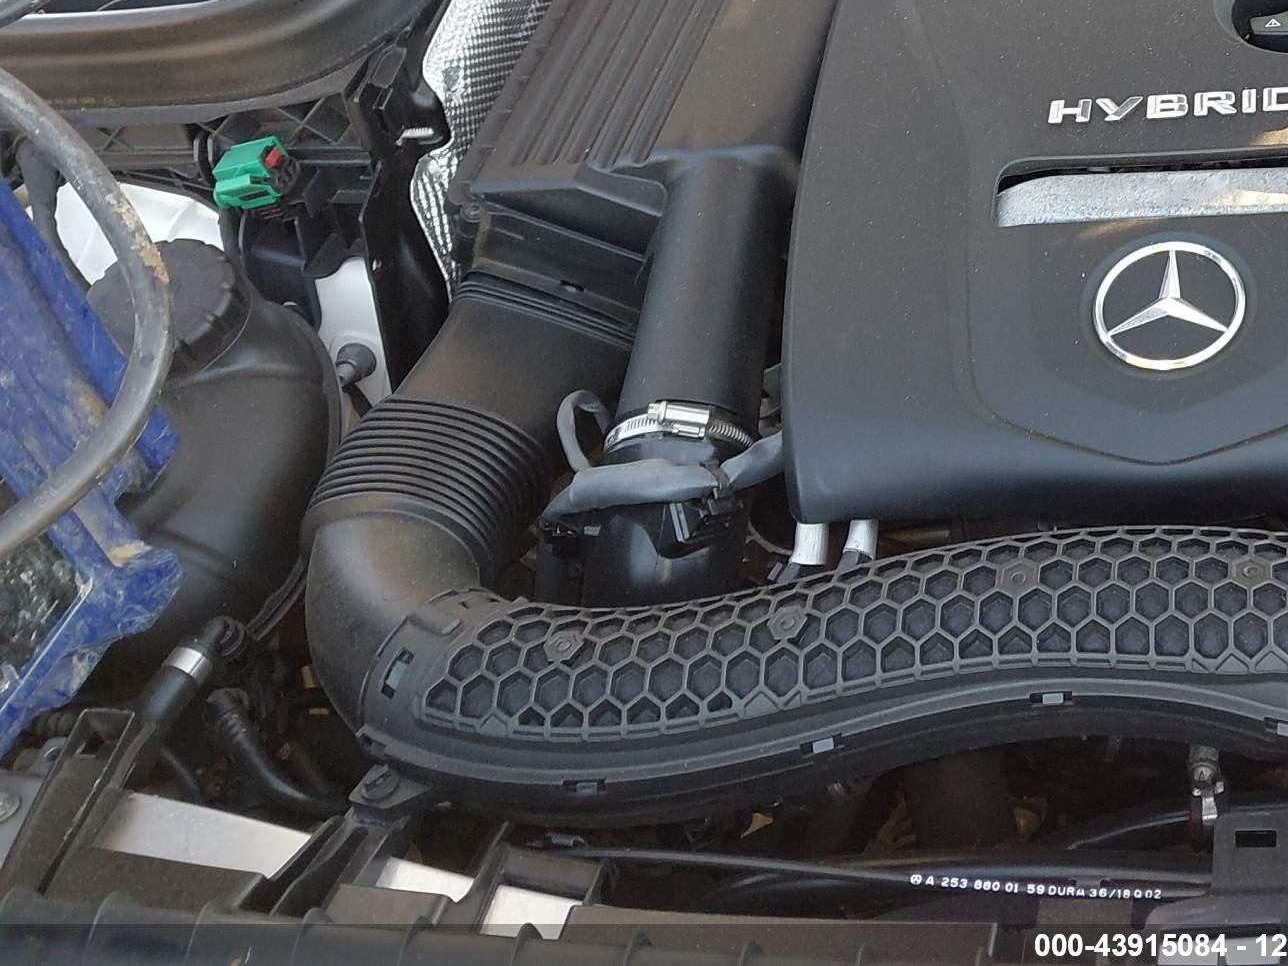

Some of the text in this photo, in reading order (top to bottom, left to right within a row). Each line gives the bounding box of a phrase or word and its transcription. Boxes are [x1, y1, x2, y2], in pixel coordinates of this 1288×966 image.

[925, 875, 935, 886] A
[941, 877, 968, 889] 253
[1005, 882, 1019, 893] 01
[1026, 884, 1046, 895] 59
